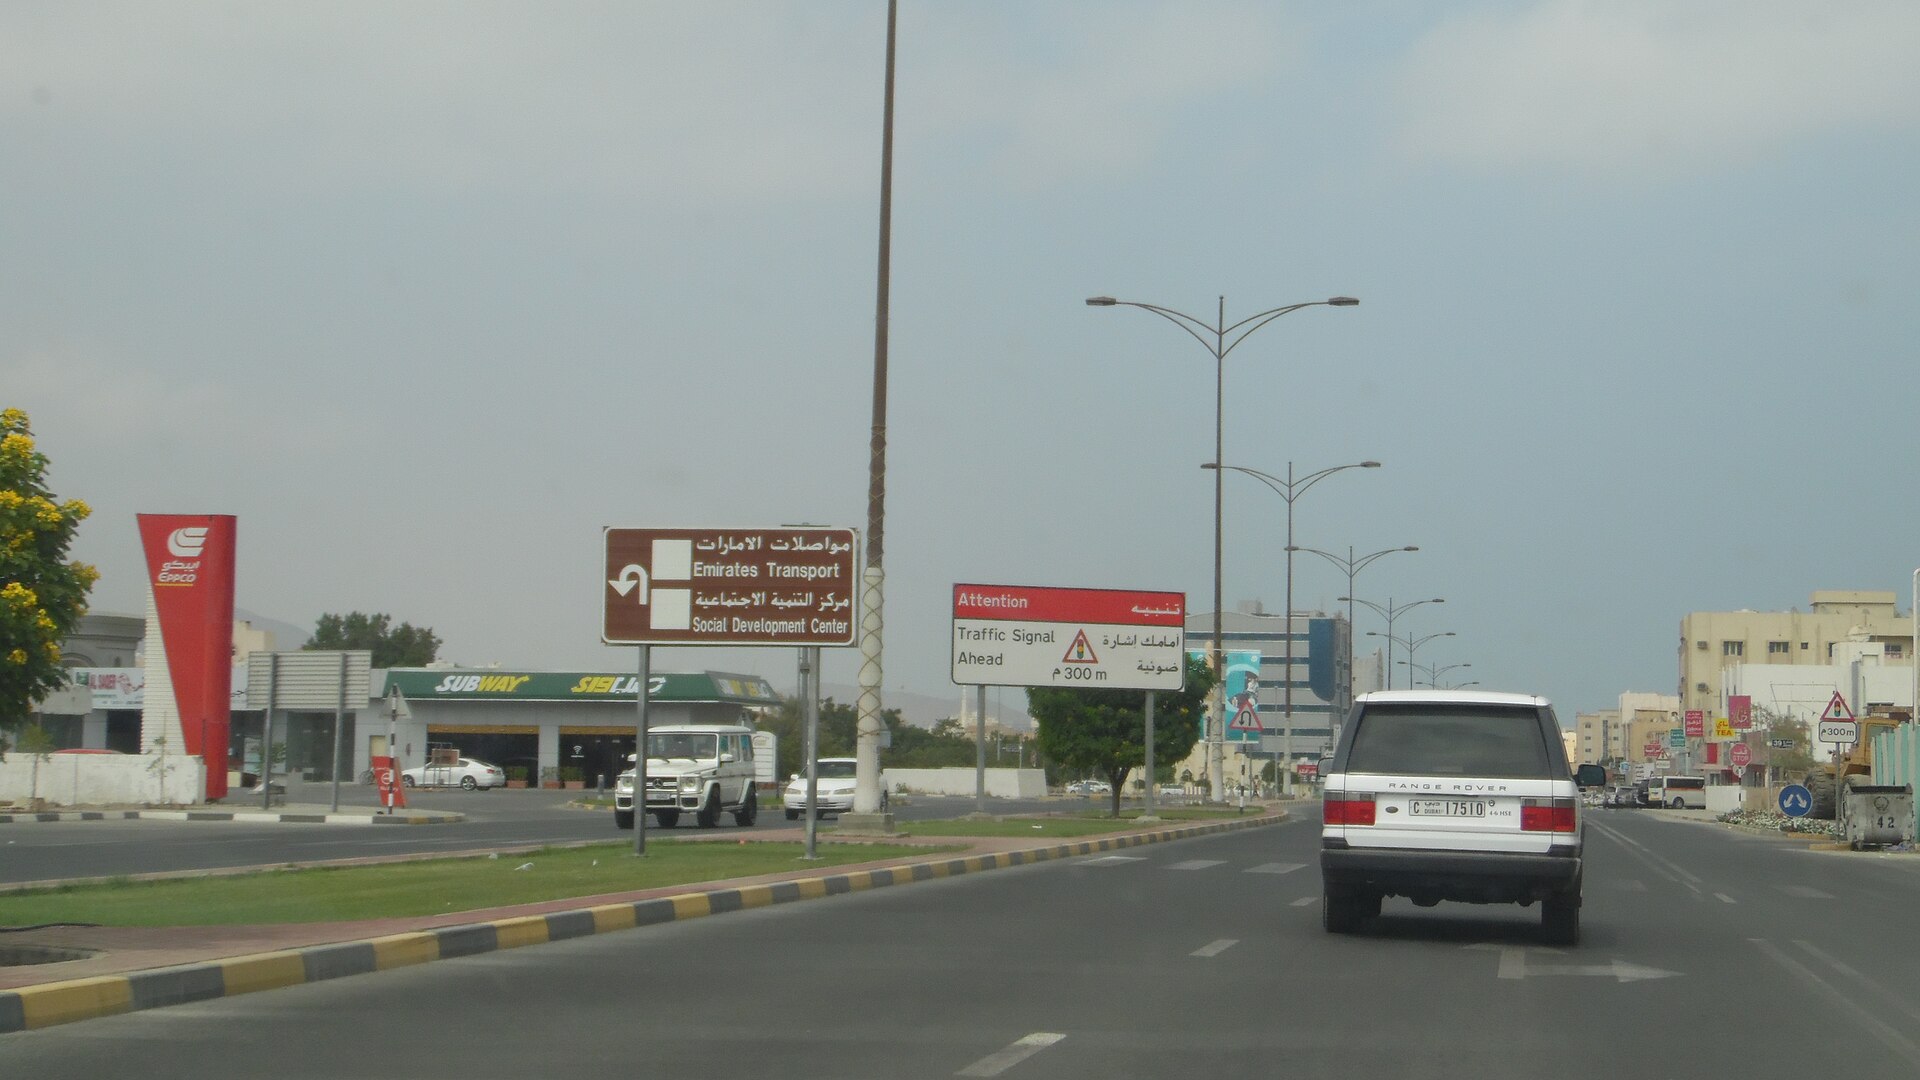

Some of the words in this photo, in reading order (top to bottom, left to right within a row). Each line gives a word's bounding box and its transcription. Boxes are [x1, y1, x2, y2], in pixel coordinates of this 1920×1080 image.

[696, 535, 762, 555] الامارات
[770, 536, 850, 555] مواصلات
[158, 572, 197, 582] EPPCO
[693, 562, 758, 578] Emirates
[766, 562, 840, 581] Transport
[695, 591, 766, 609] الاجتماعية
[771, 591, 813, 610] التنمية
[818, 592, 849, 612] مركز
[957, 592, 1028, 608] Attention
[1131, 603, 1181, 617] تنبيه
[692, 617, 727, 633] Social
[732, 617, 806, 636] Development
[811, 618, 848, 634] Center
[957, 627, 1006, 641] Traffic
[1012, 629, 1055, 645] Signal
[957, 651, 1003, 666] Ahead
[1064, 667, 1092, 680] 300
[1095, 671, 1107, 681] m
[434, 675, 530, 692] SUBWAY
[1453, 784, 1507, 792] ROVER
[1413, 802, 1420, 814] C
[1446, 802, 1483, 816] 17510
